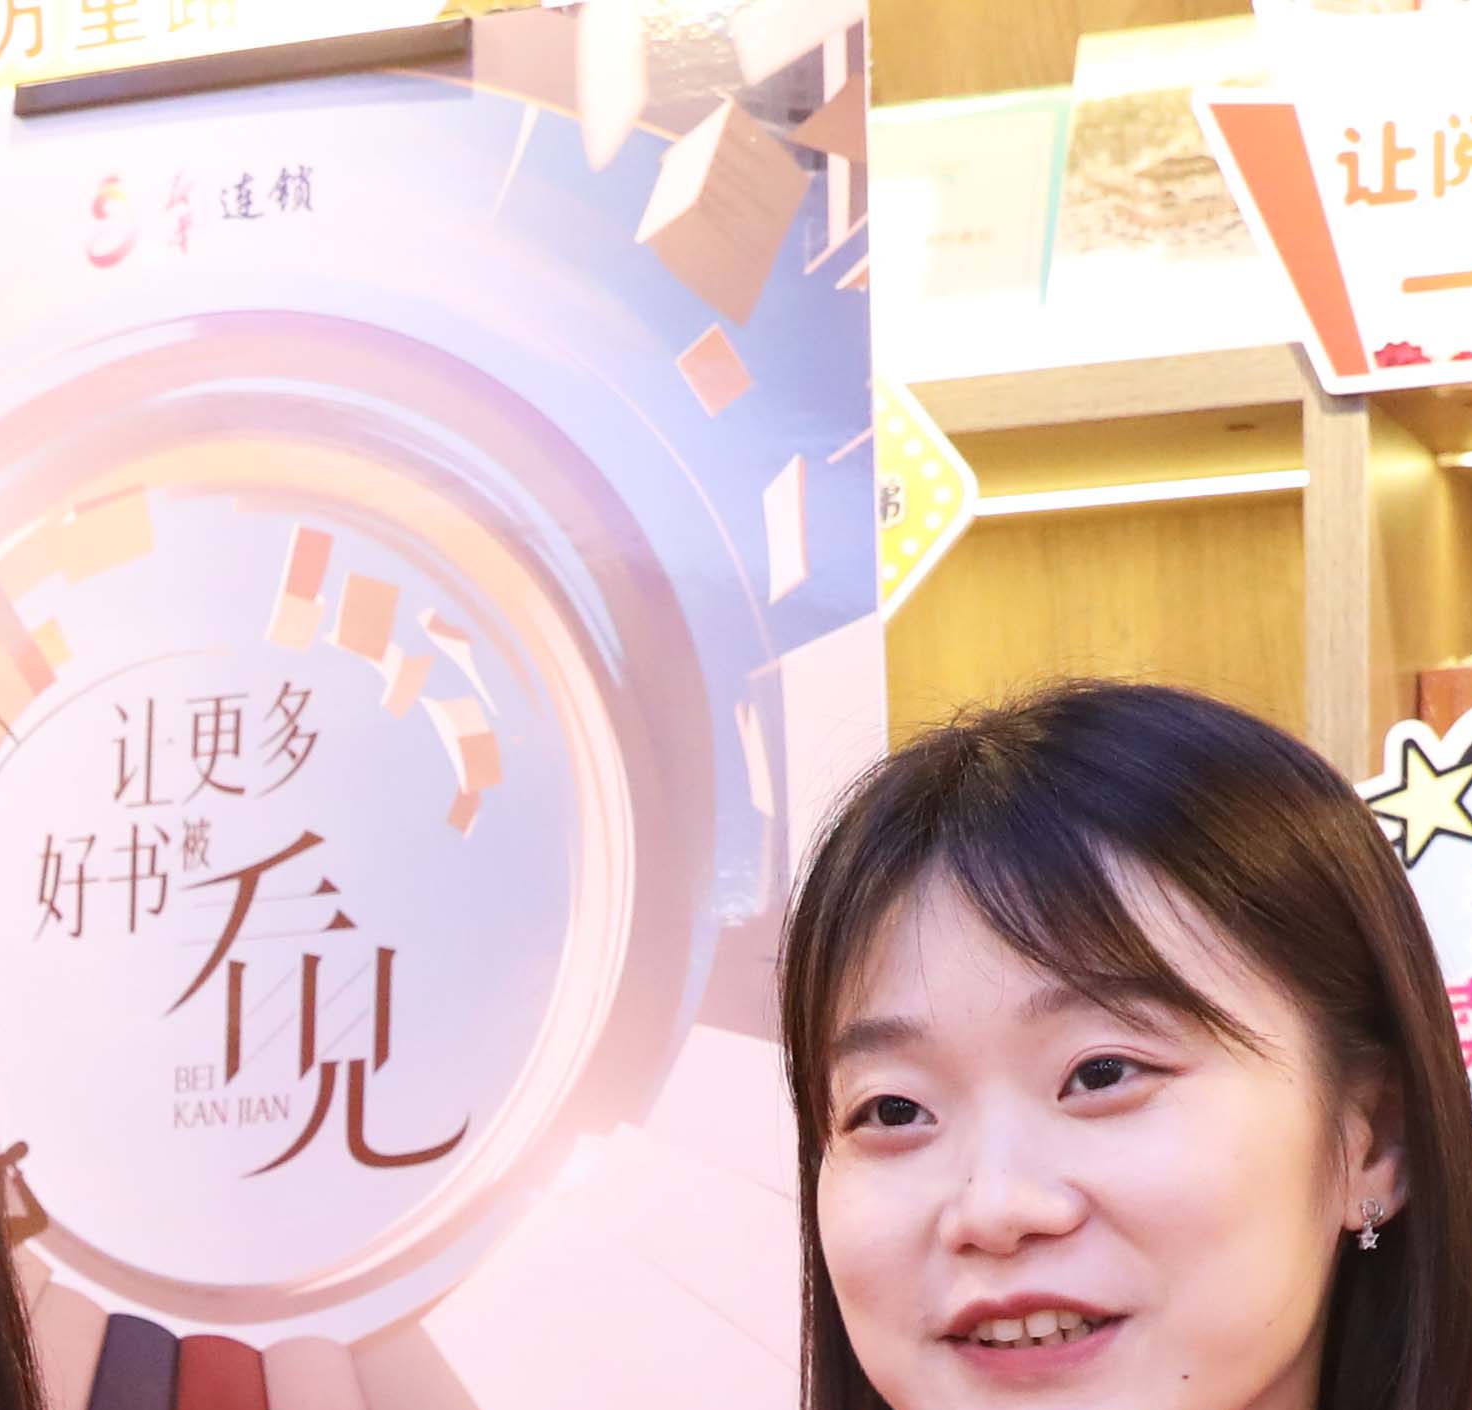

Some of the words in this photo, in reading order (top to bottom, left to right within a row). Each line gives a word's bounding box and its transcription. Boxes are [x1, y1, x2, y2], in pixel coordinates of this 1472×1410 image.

[111, 681, 319, 807] 让更多
[173, 1064, 216, 1095] BEI
[172, 1097, 228, 1129] KAN
[236, 1094, 291, 1128] JIAN
